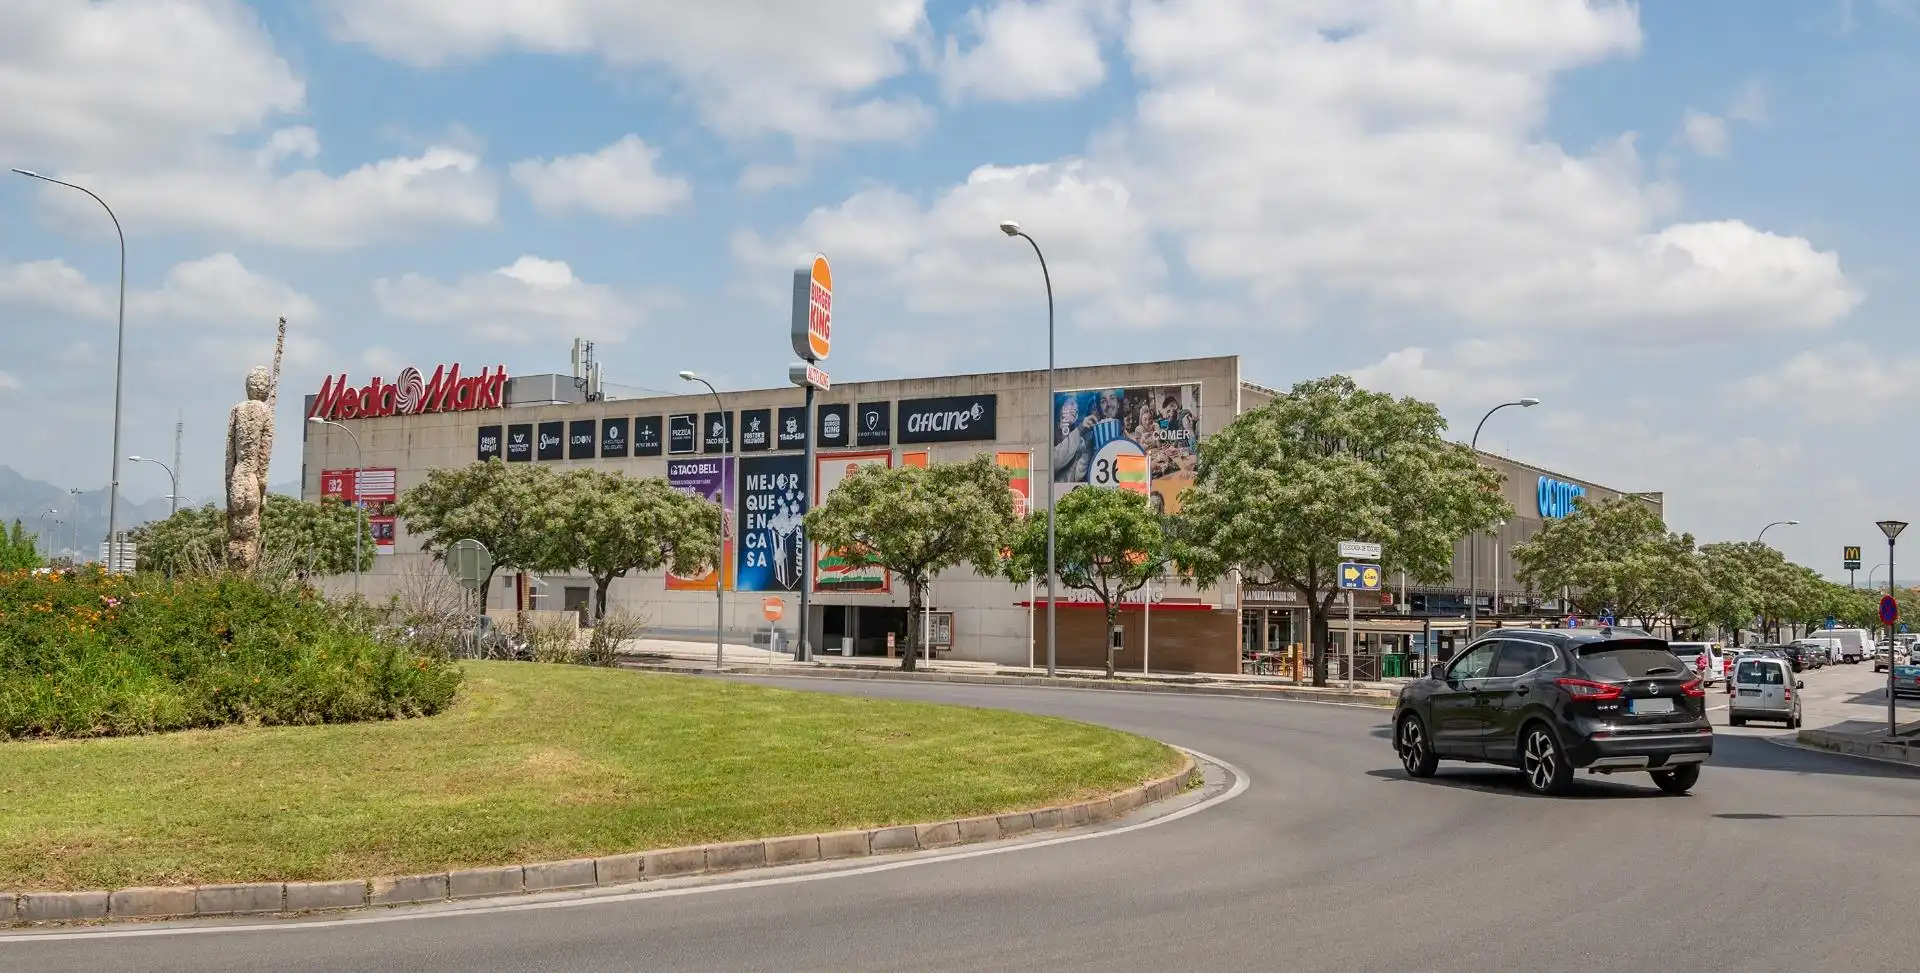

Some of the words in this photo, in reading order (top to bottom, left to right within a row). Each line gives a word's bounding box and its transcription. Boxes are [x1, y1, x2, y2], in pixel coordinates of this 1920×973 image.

[811, 281, 831, 314] BURGER
[809, 302, 830, 341] KING
[308, 373, 400, 421] Media
[416, 363, 509, 415] Markt
[823, 425, 841, 434] KING
[907, 410, 970, 433] aficine
[571, 435, 592, 445] UDON
[1152, 429, 1191, 442] COMER
[678, 464, 698, 476] TACO
[698, 462, 719, 475] BELL
[746, 495, 776, 511] QUE
[746, 513, 768, 530] EN
[745, 532, 768, 549] CA
[746, 551, 768, 568] SA
